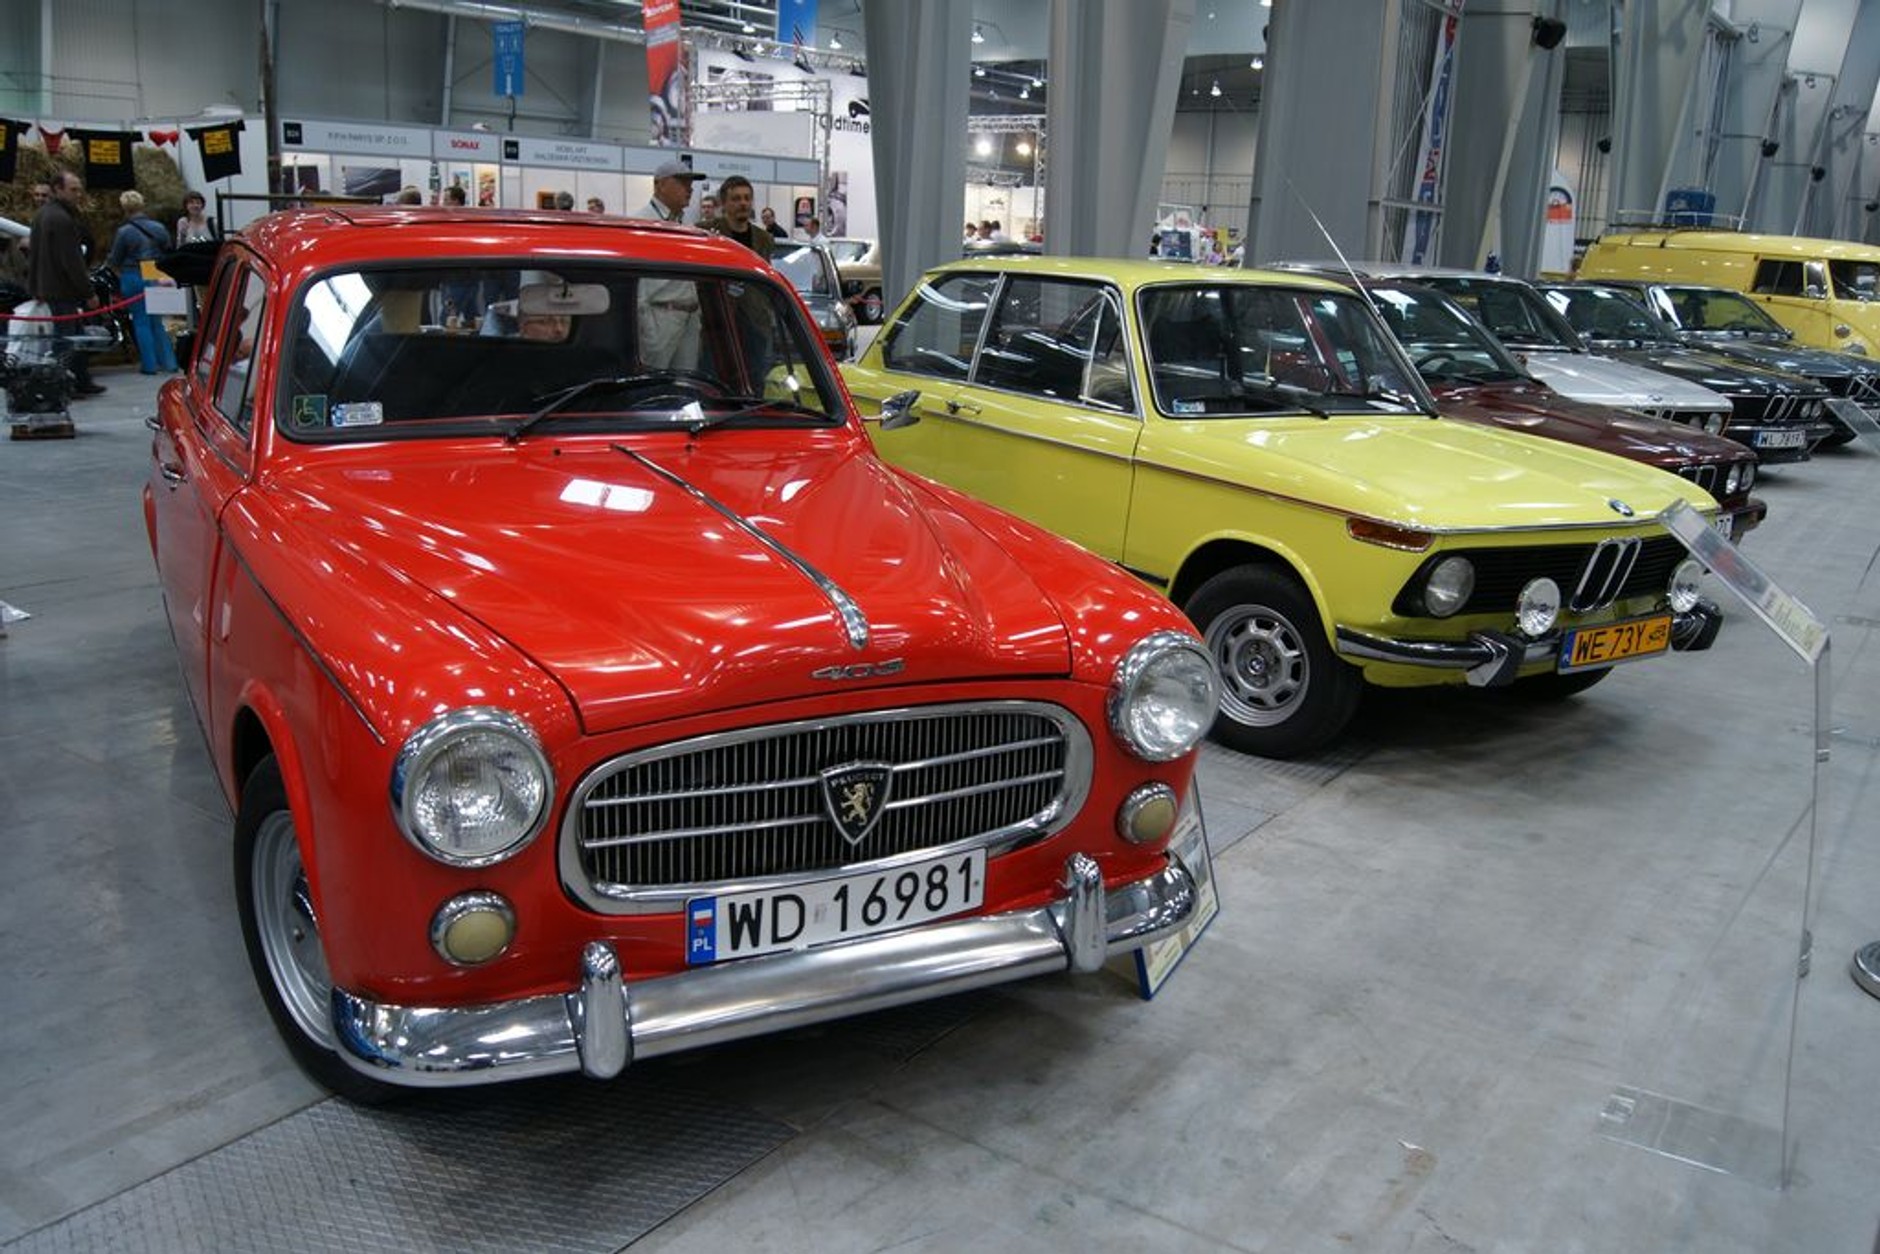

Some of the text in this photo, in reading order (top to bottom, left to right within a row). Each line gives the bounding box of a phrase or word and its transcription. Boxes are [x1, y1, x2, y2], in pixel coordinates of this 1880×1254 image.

[451, 139, 480, 149] SONAX
[1576, 624, 1646, 662] WE 73Y
[728, 856, 973, 951] WD 16981
[692, 937, 713, 953] PL
